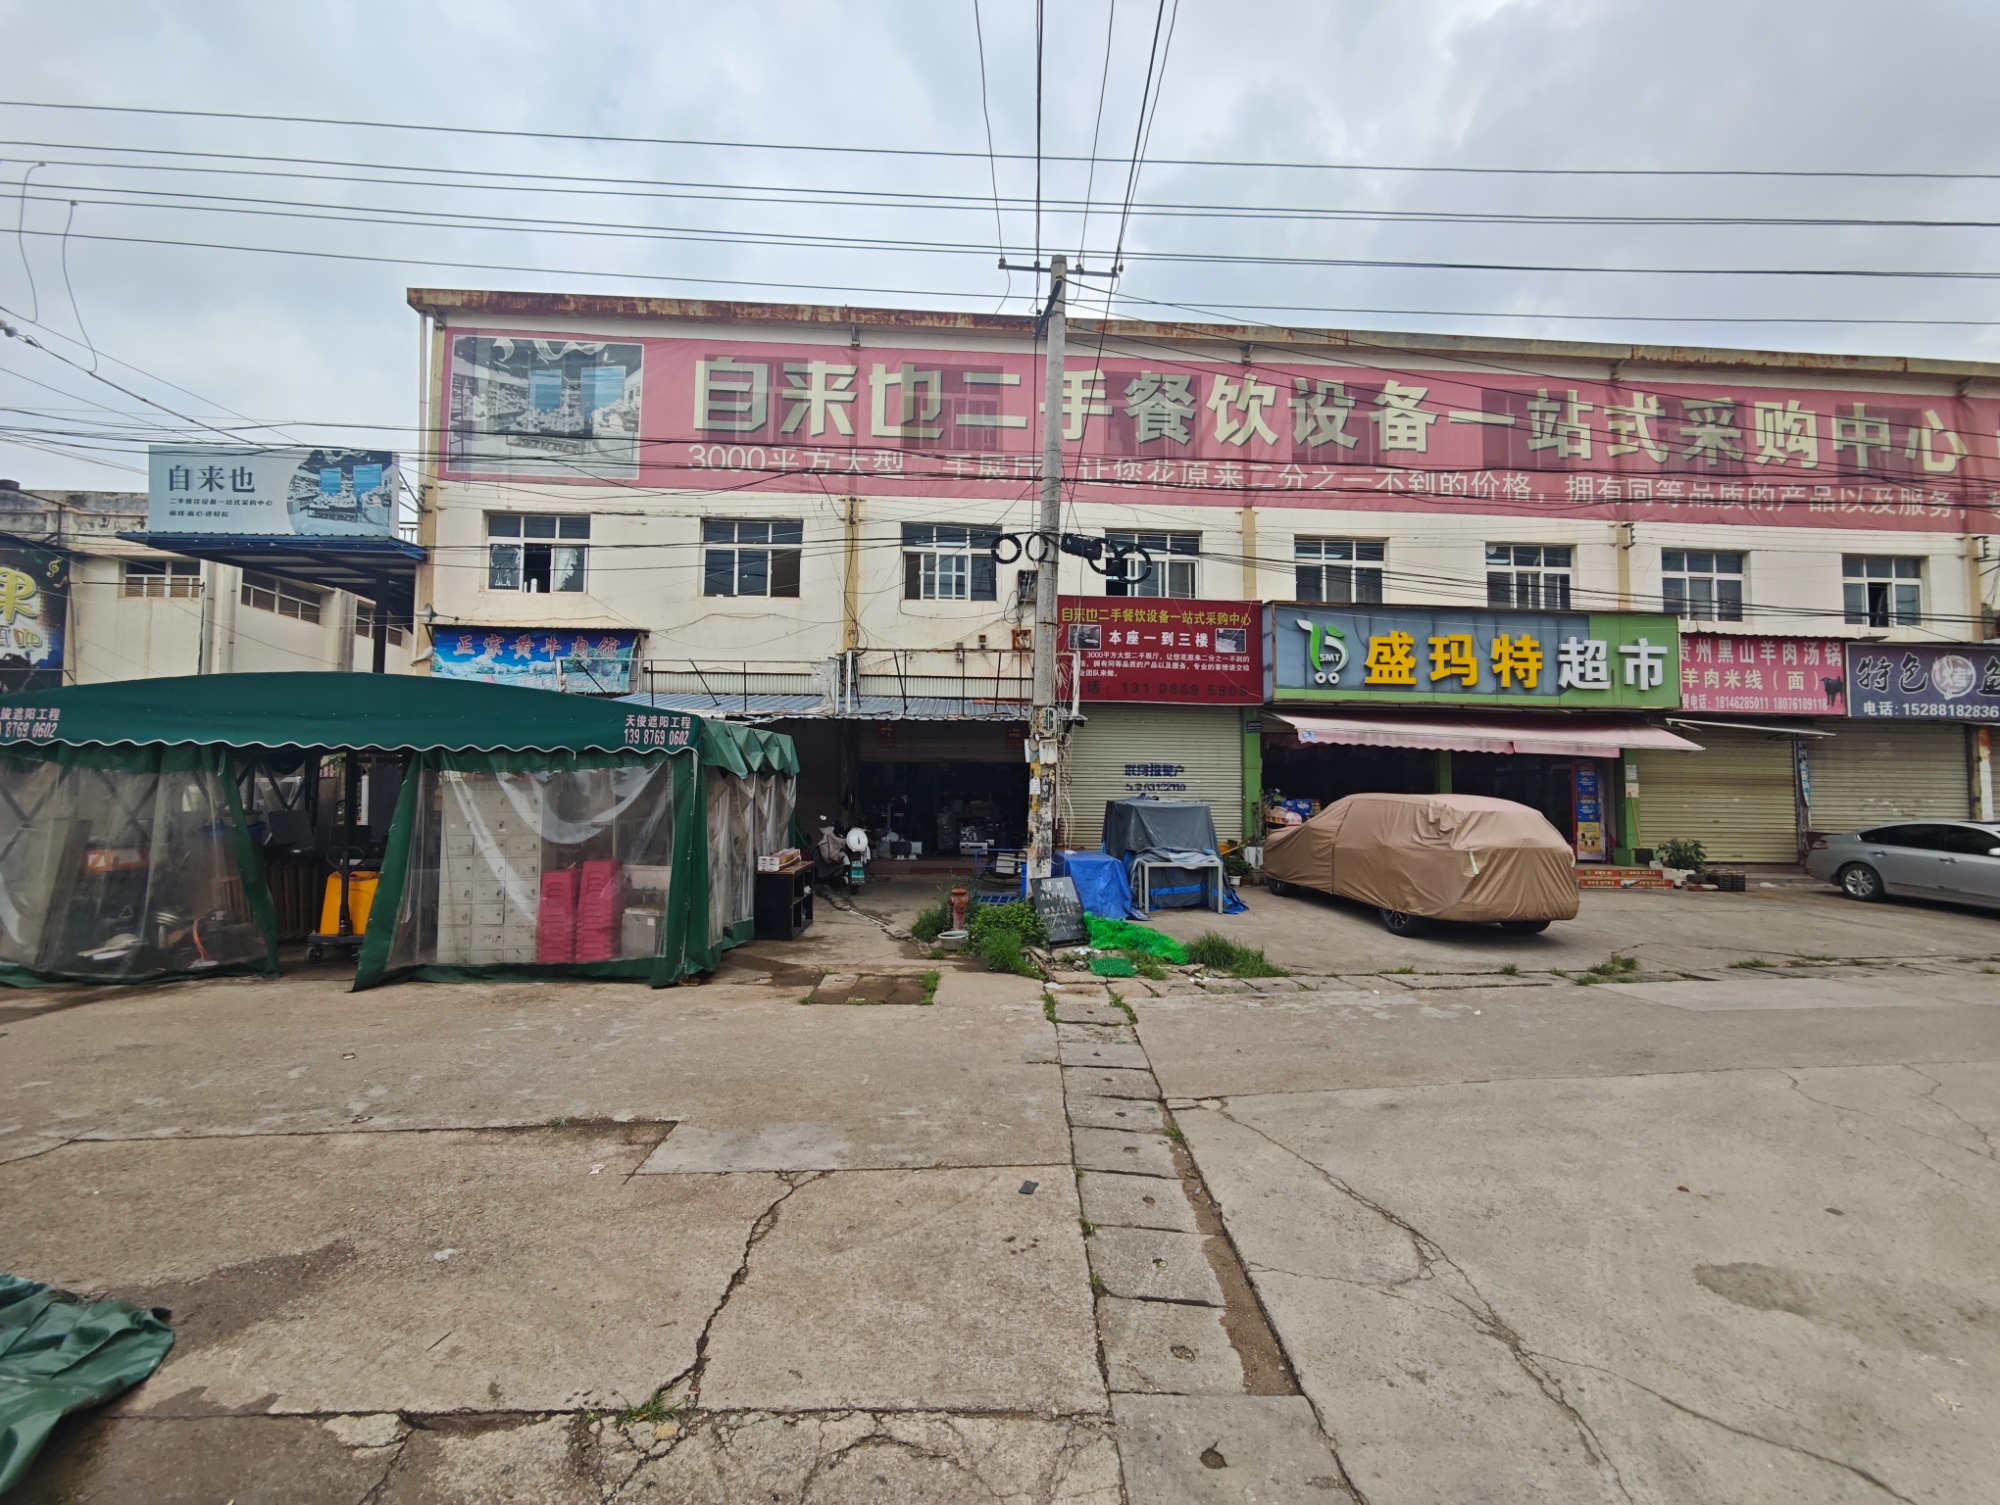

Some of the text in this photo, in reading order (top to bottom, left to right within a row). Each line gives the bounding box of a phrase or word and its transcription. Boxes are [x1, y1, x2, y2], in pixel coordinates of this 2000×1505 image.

[169, 465, 256, 493] 自来也
[1061, 607, 1252, 627] 自来也二手餐饮设备一站式采购中心
[452, 633, 621, 660] 正宗黄牛肉馆
[1108, 629, 1209, 648] 本座一到三楼
[1319, 653, 1341, 662] SMT
[1364, 629, 1668, 691] 盛玛特超市
[1122, 682, 1149, 694] 131
[1682, 668, 1819, 691] 羊肉米线（面）
[32, 722, 57, 739] 0602
[625, 715, 691, 728] 天俊遮阳工程
[624, 728, 690, 746] 139 8769 0602
